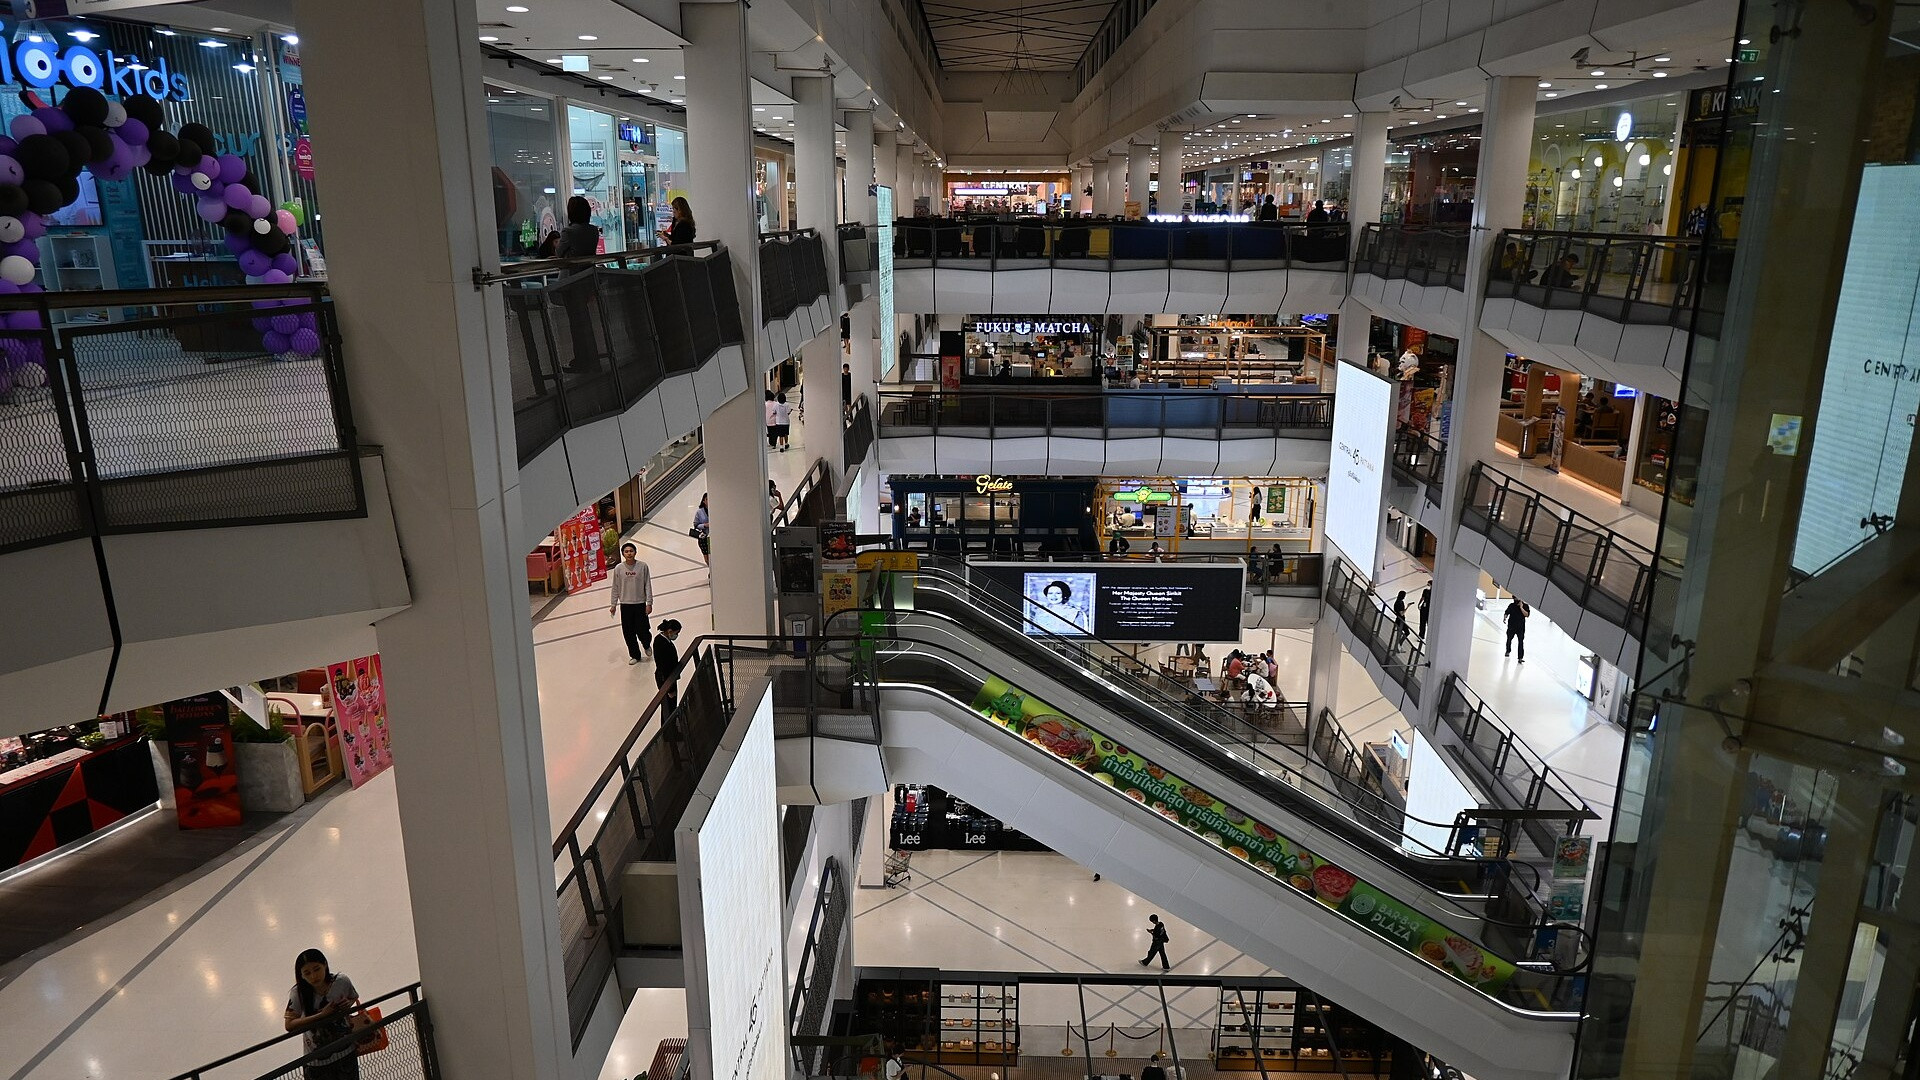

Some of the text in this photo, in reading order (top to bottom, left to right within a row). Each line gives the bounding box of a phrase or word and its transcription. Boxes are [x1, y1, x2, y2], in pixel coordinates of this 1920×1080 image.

[107, 49, 189, 101] kids
[976, 322, 1091, 334] FUKU MATCHA
[1102, 756, 1185, 809] ทำมื้อนี้ให้ดีที่สุด
[1265, 842, 1284, 865] ชั้น
[1283, 855, 1296, 870] 4
[900, 833, 920, 844] Lee
[965, 832, 985, 844] Lee
[1371, 914, 1411, 942] PLAZA
[1548, 939, 1555, 948] 3
